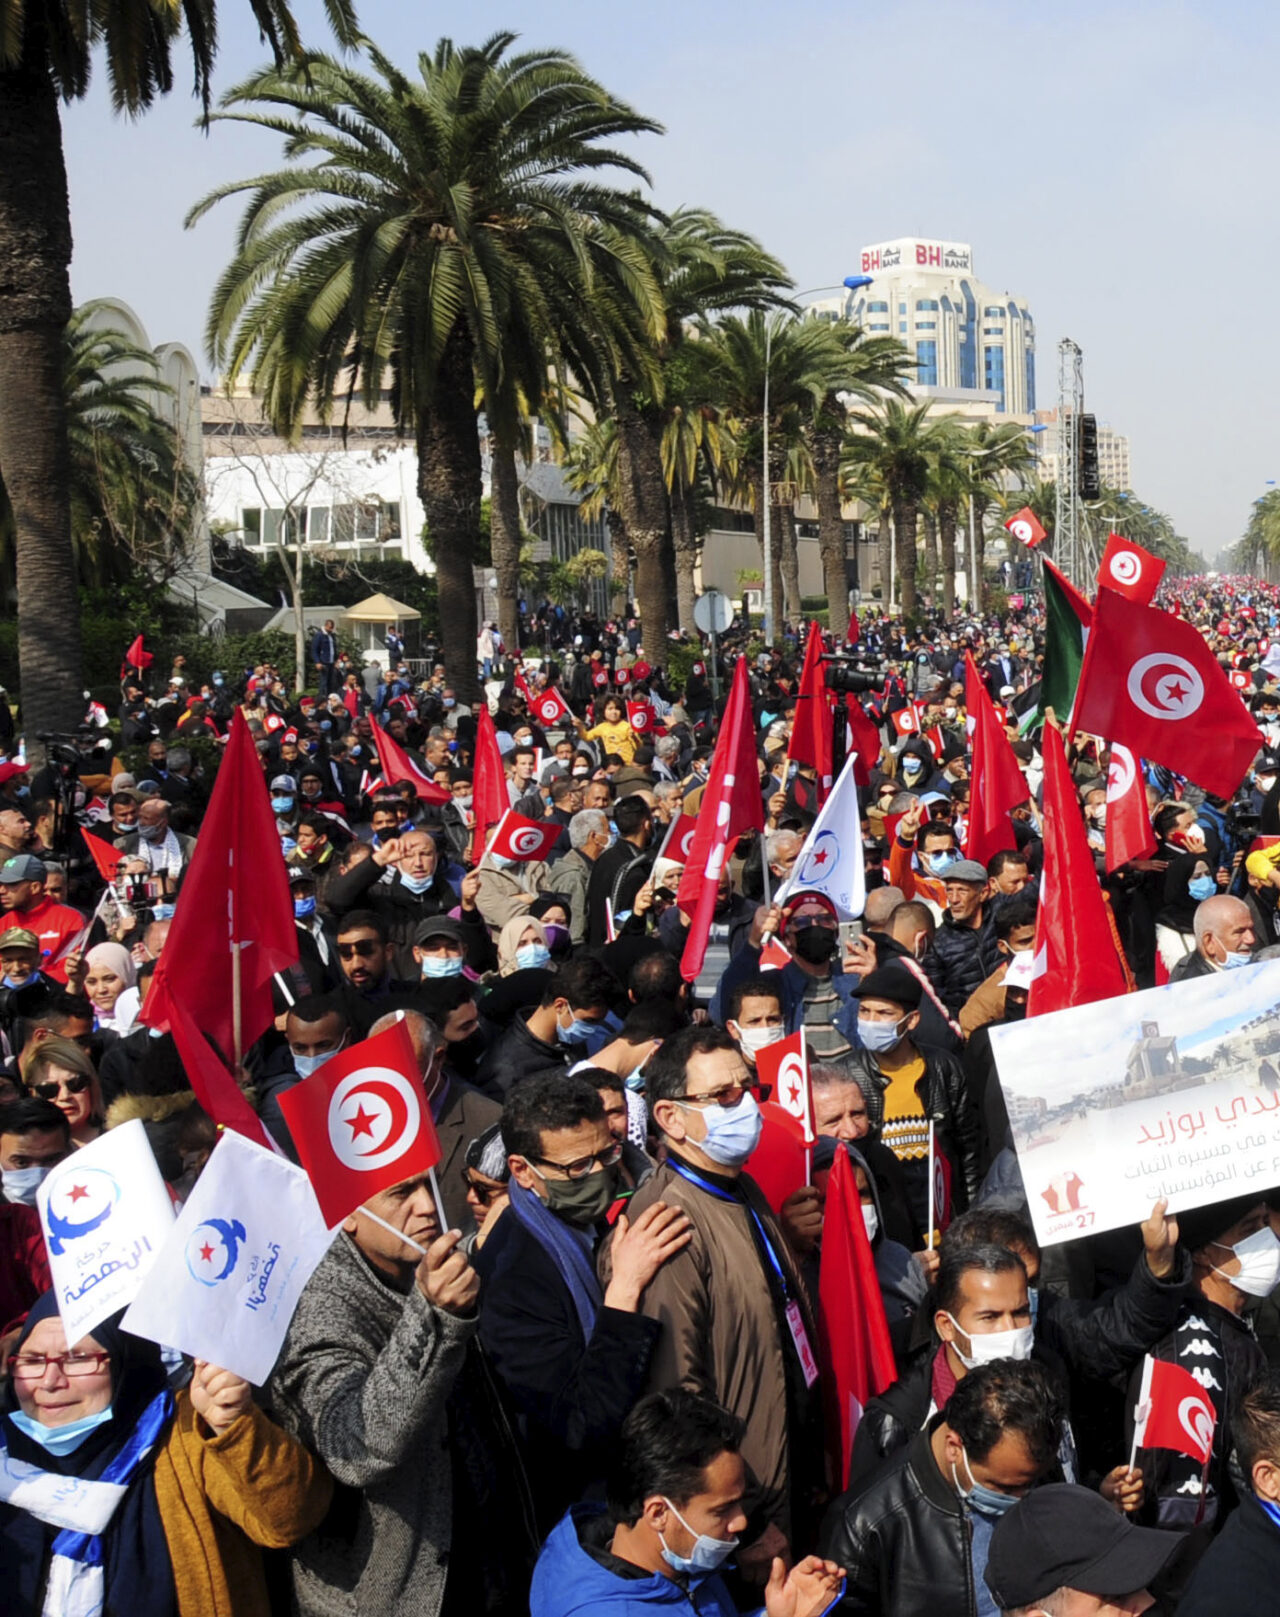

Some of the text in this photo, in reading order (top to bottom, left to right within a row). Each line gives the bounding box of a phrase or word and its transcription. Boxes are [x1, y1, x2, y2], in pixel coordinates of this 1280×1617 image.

[861, 249, 880, 273] BH
[882, 256, 900, 268] BANK
[915, 244, 941, 267] BH
[944, 258, 969, 269] BANK
[1137, 1110, 1208, 1146] بوزيد
[1236, 1131, 1268, 1153] في
[1124, 1154, 1173, 1180] الثبات
[1178, 1143, 1232, 1167] مسيرة
[1145, 1163, 1238, 1200] المؤسسات
[1243, 1160, 1268, 1179] عن
[1076, 1211, 1096, 1228] 27
[76, 1241, 111, 1268] حركة
[64, 1236, 152, 1304] النهضة
